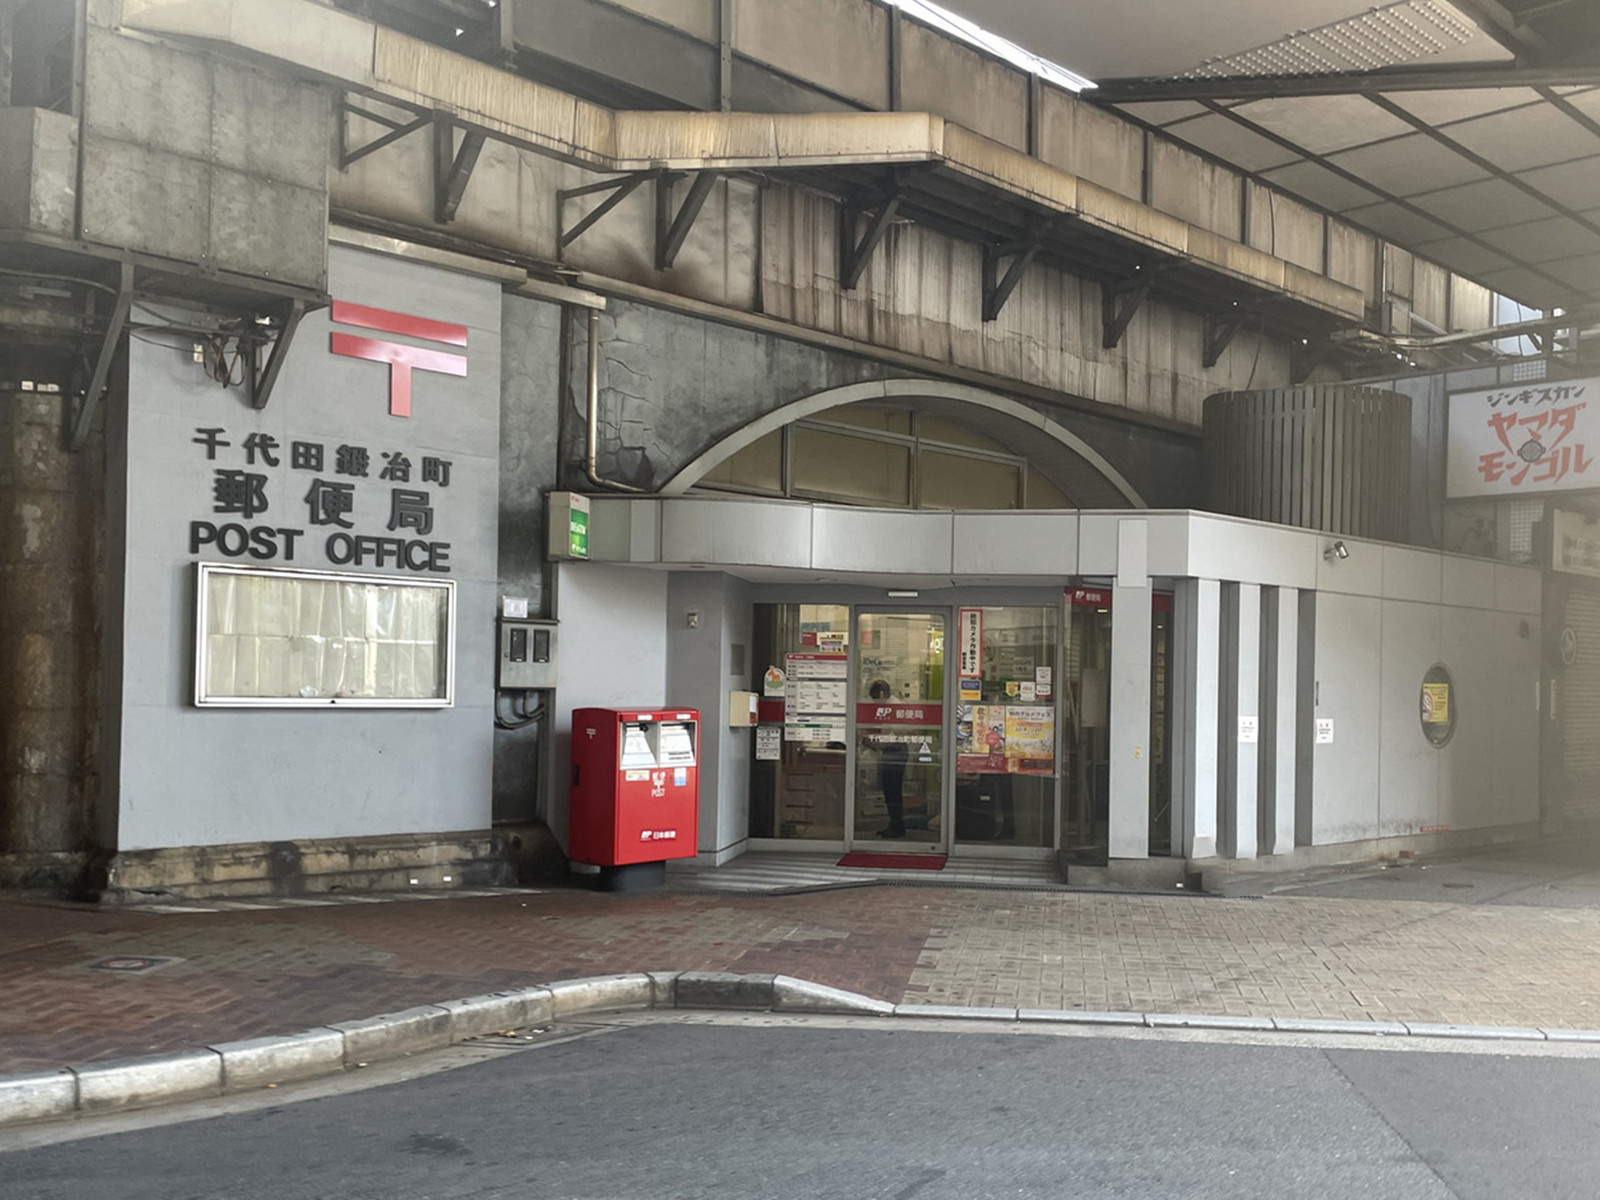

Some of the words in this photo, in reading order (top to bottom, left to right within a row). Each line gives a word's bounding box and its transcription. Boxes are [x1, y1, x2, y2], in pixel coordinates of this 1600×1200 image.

[1486, 386, 1586, 407] ジンギスカン
[1487, 402, 1587, 456] ヤマダ
[193, 428, 453, 487] 千代田鍛冶町
[1478, 444, 1594, 486] モンゴル
[213, 468, 434, 535] 郵便局
[190, 521, 304, 560] POST
[325, 532, 451, 572] OFFICE
[896, 709, 924, 719] 郵便局
